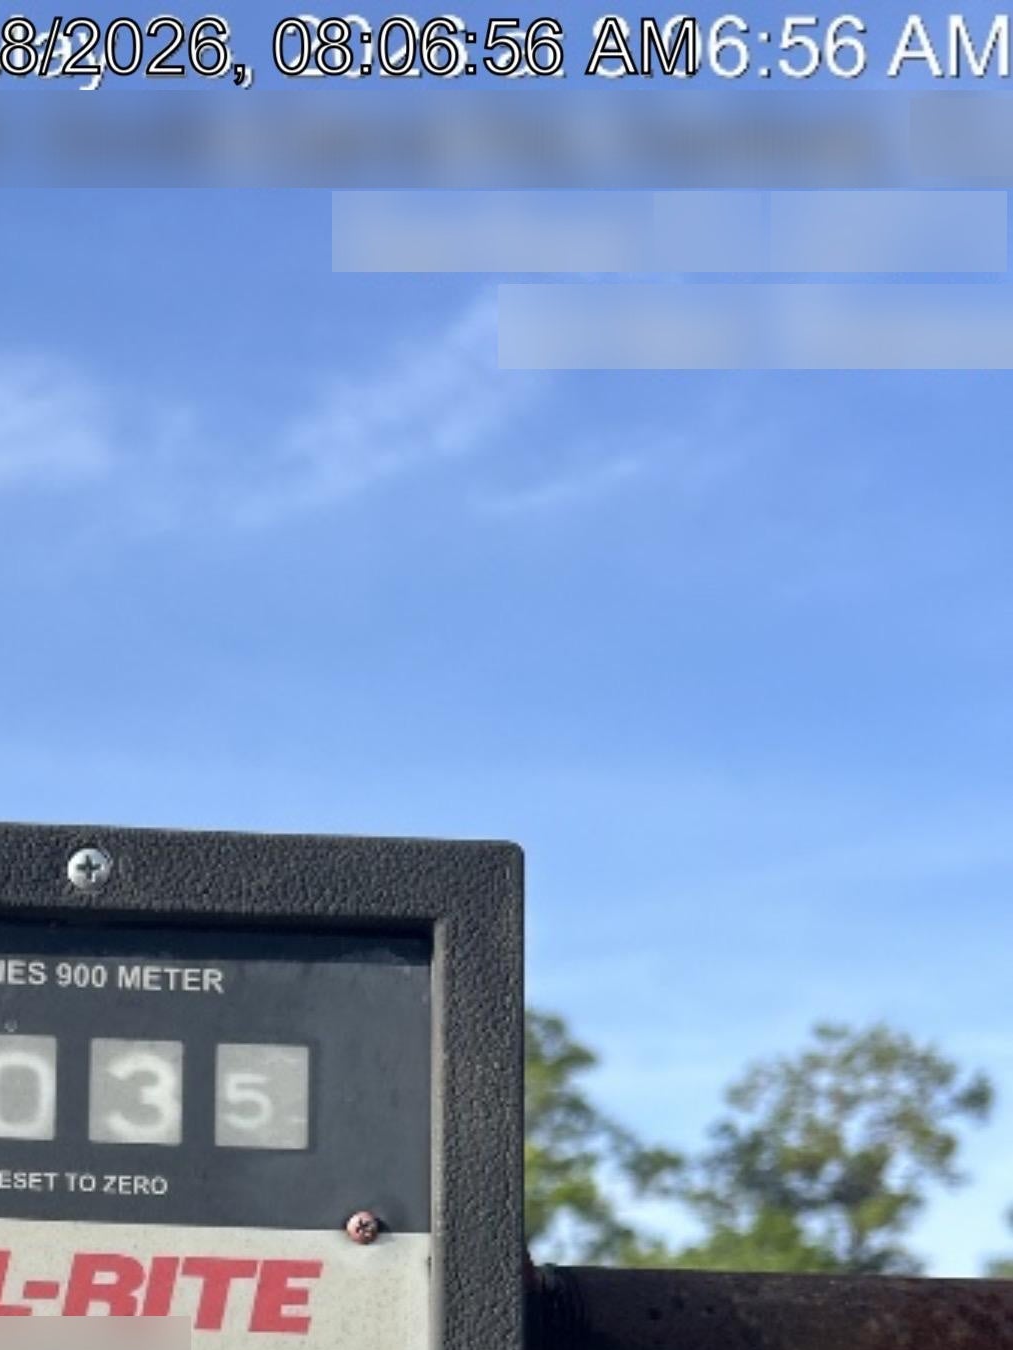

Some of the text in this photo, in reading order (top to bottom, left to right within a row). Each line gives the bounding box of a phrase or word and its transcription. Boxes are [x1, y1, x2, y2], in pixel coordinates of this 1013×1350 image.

[56, 964, 108, 989] 900
[116, 965, 225, 994] METER
[64, 1173, 97, 1194] TO
[103, 1174, 169, 1197] ZERO
